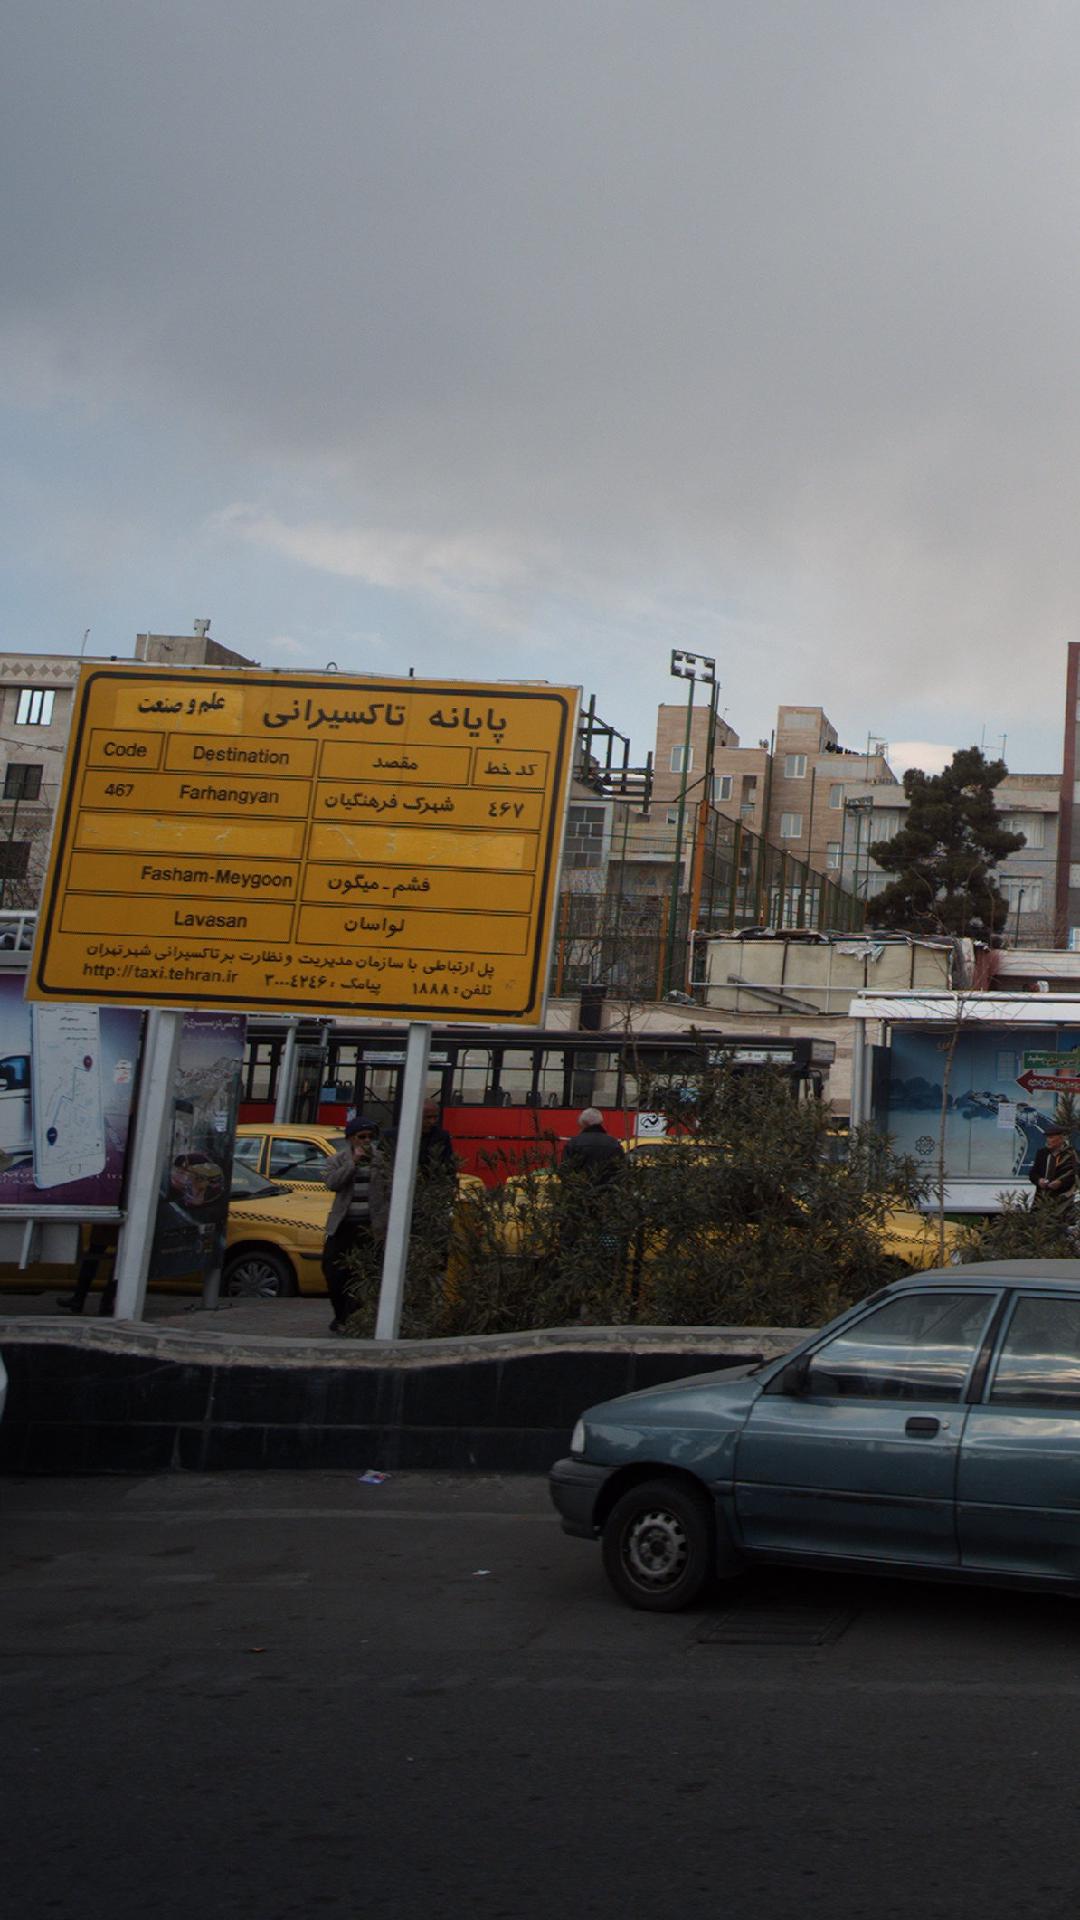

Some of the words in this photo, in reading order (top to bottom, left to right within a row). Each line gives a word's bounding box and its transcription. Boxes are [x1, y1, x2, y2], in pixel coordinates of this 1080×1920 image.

[138, 698, 183, 713] صنعت
[185, 698, 195, 714] و
[198, 692, 225, 715] علم
[263, 699, 406, 729] تاکسیرانی
[429, 707, 507, 743] پایانه
[103, 742, 148, 758] Code
[193, 745, 290, 765] Destination
[372, 755, 418, 771] مقصد
[484, 761, 511, 776] خط
[515, 763, 538, 777] کد
[104, 783, 134, 797] 467
[178, 785, 280, 805] Farhangyan
[325, 792, 398, 813] فرهنگیان
[403, 795, 455, 814] شهرک
[141, 866, 293, 889] Fasham-Meygoon
[174, 911, 248, 928] Lavasan
[343, 916, 405, 938] لواسان
[87, 943, 123, 957] تهران
[124, 943, 151, 959] شهر
[154, 946, 220, 962] تاکسیرانی
[239, 950, 282, 966] نظارت
[299, 954, 353, 968] مدیریت
[355, 956, 403, 972] سازمان
[408, 958, 417, 971] با
[422, 960, 474, 976] ارتباطی
[82, 963, 239, 984] http://taxi.tehran.ir
[478, 962, 495, 978] پل
